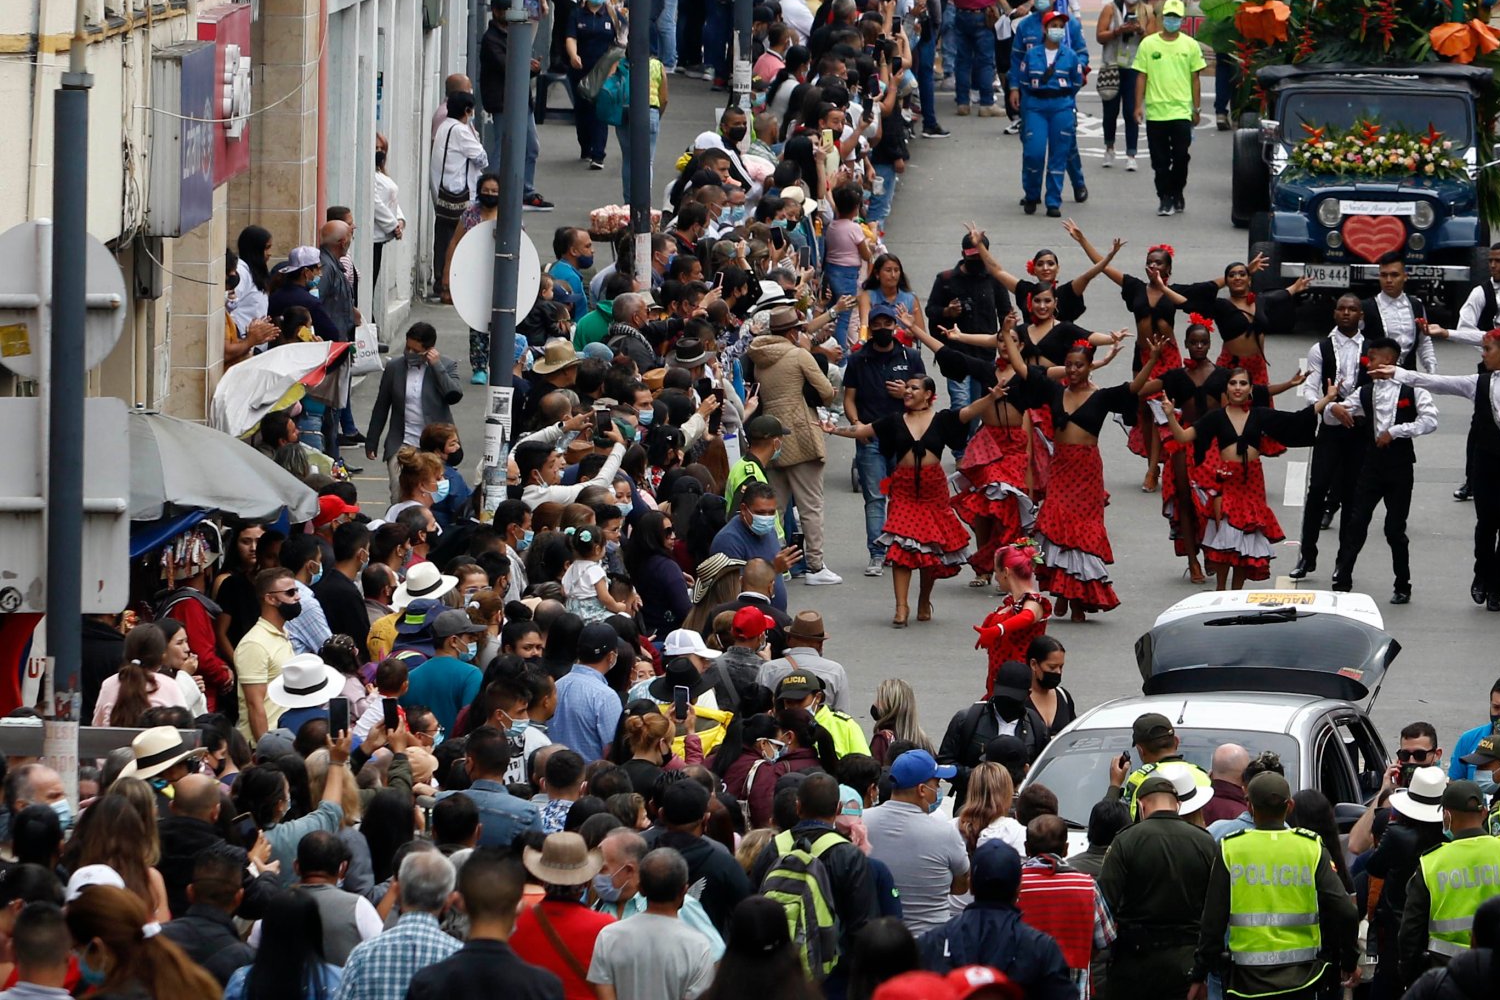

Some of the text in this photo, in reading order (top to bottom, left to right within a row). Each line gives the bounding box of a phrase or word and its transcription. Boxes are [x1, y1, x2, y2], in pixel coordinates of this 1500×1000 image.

[1326, 249, 1344, 257] Jeep
[1406, 252, 1425, 260] Jeep
[1329, 268, 1348, 281] 444
[1408, 265, 1443, 277] Jeep
[1231, 863, 1312, 887] POLICIA
